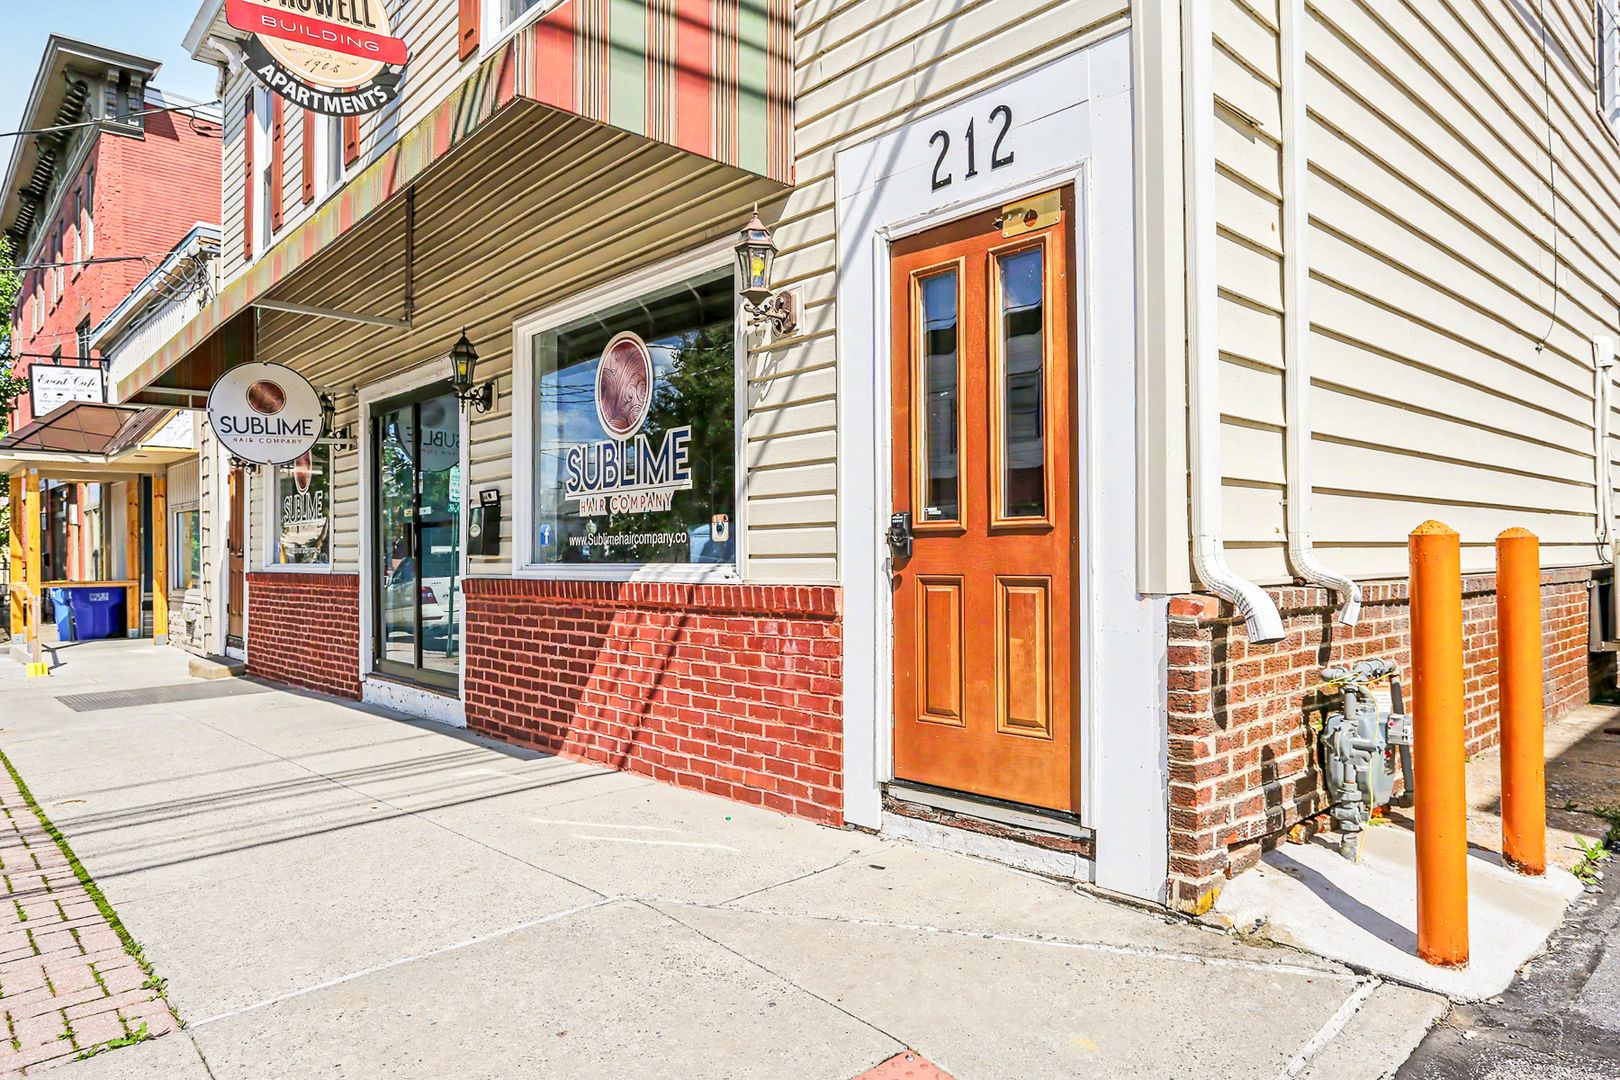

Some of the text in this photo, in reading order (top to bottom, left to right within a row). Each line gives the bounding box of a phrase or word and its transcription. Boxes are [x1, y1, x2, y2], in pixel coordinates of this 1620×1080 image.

[261, 15, 380, 52] BUILDING
[257, 63, 388, 114] APARTMENTS
[928, 104, 1015, 192] 212
[37, 373, 69, 385] Event
[220, 416, 314, 437] SUBLIME
[565, 425, 692, 495] SUBLIME
[283, 491, 323, 523] SUBLIME
[580, 493, 672, 514] HAIR COMPANY
